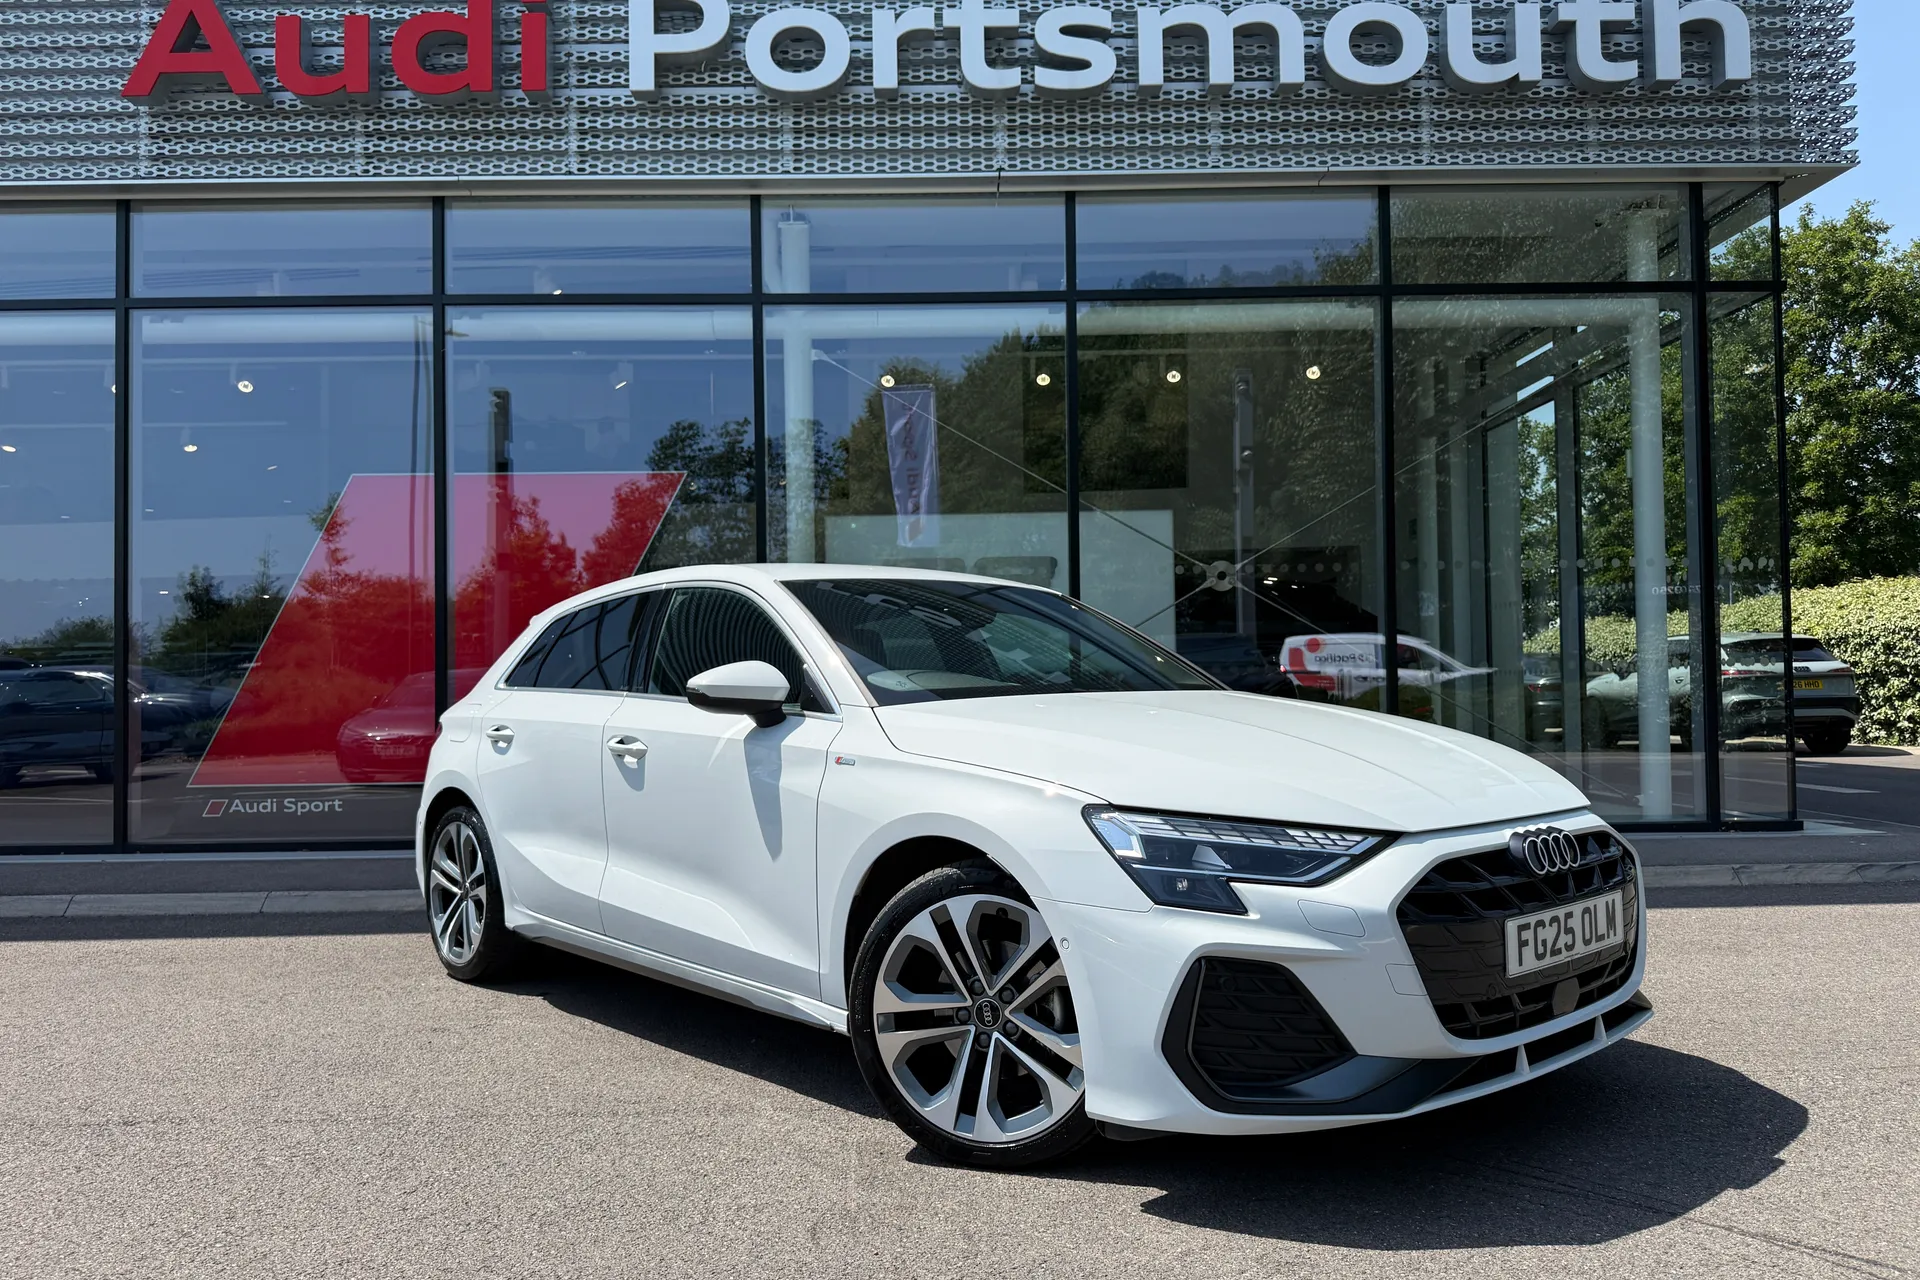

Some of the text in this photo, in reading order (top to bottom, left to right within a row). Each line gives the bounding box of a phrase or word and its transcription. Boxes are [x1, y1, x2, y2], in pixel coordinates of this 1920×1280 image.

[121, 0, 1752, 97] Audi Portsmouth
[229, 798, 343, 815] Audi Sport
[1517, 898, 1617, 967] FG25 OLM
